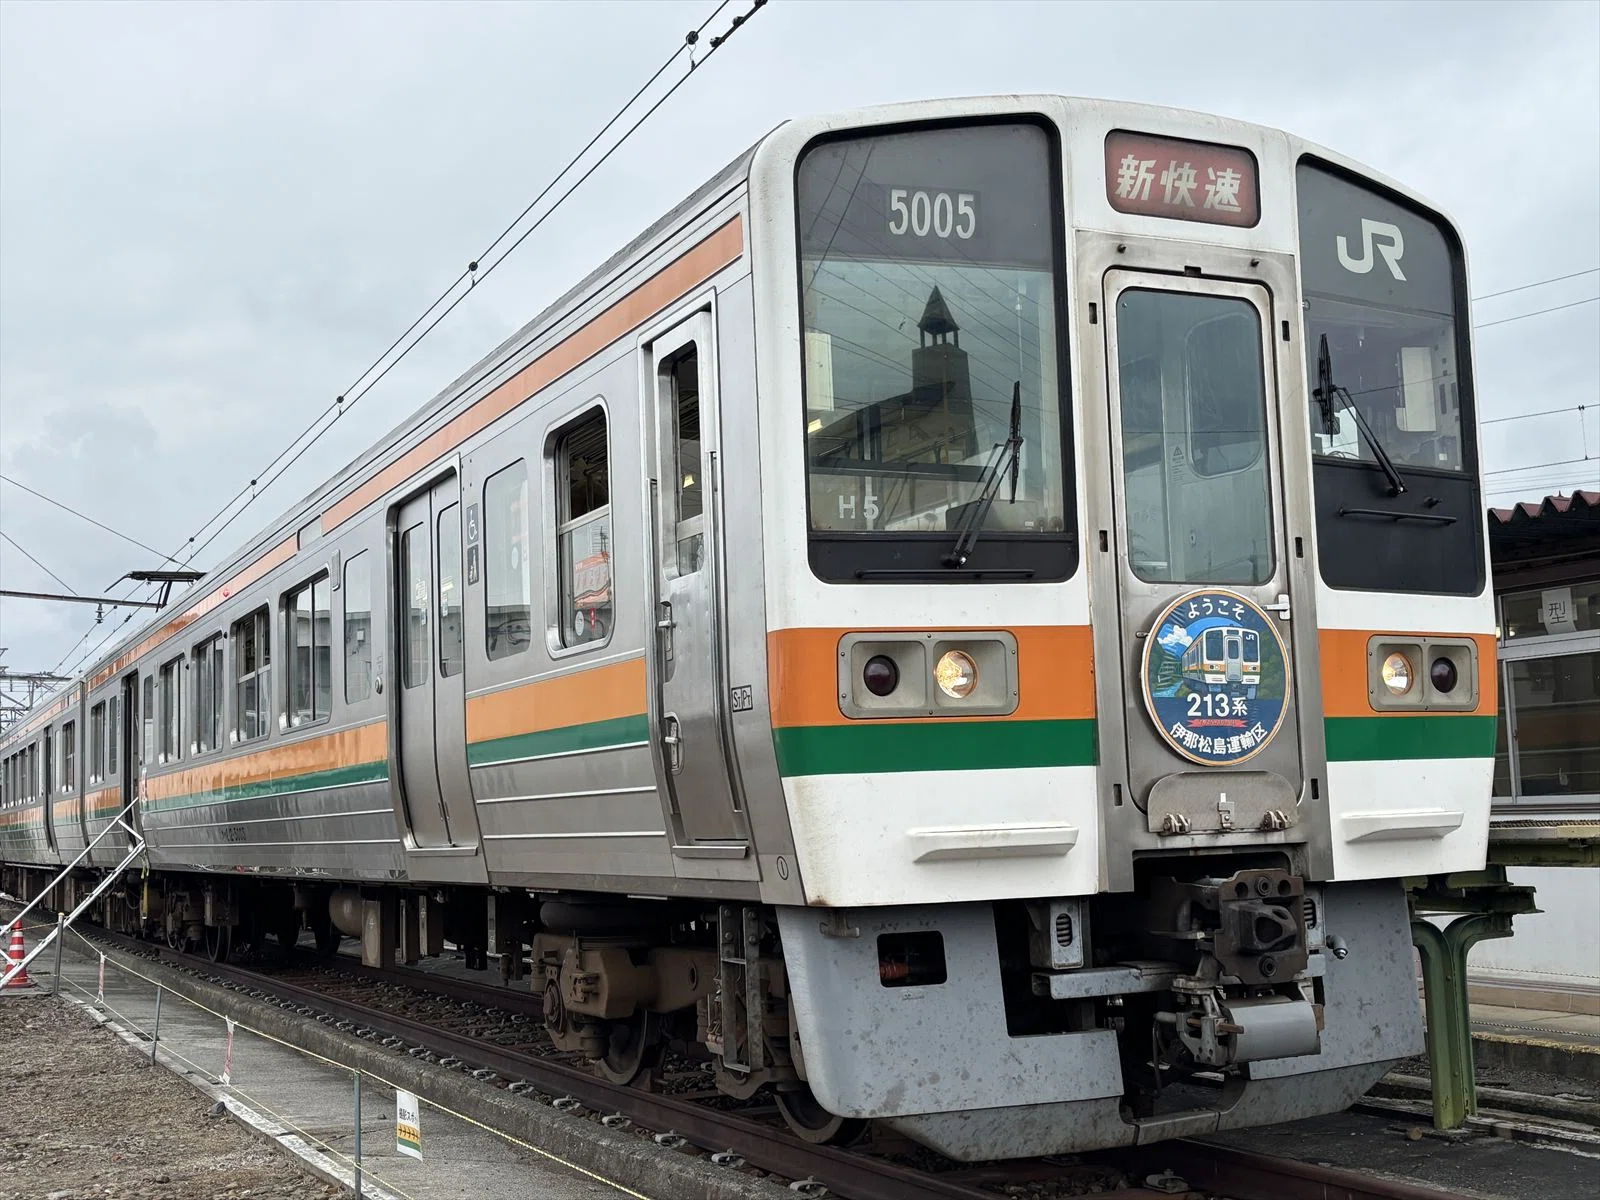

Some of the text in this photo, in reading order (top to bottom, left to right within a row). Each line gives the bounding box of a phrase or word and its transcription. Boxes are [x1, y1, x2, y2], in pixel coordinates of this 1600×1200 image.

[1114, 154, 1242, 213] 新快速
[889, 189, 976, 239] 5005
[1336, 218, 1408, 281] JR
[1187, 598, 1246, 621] ようこそ
[1548, 600, 1569, 625] 型
[1187, 693, 1248, 717] 213系
[1169, 722, 1268, 755] 伊那松島運輸区
